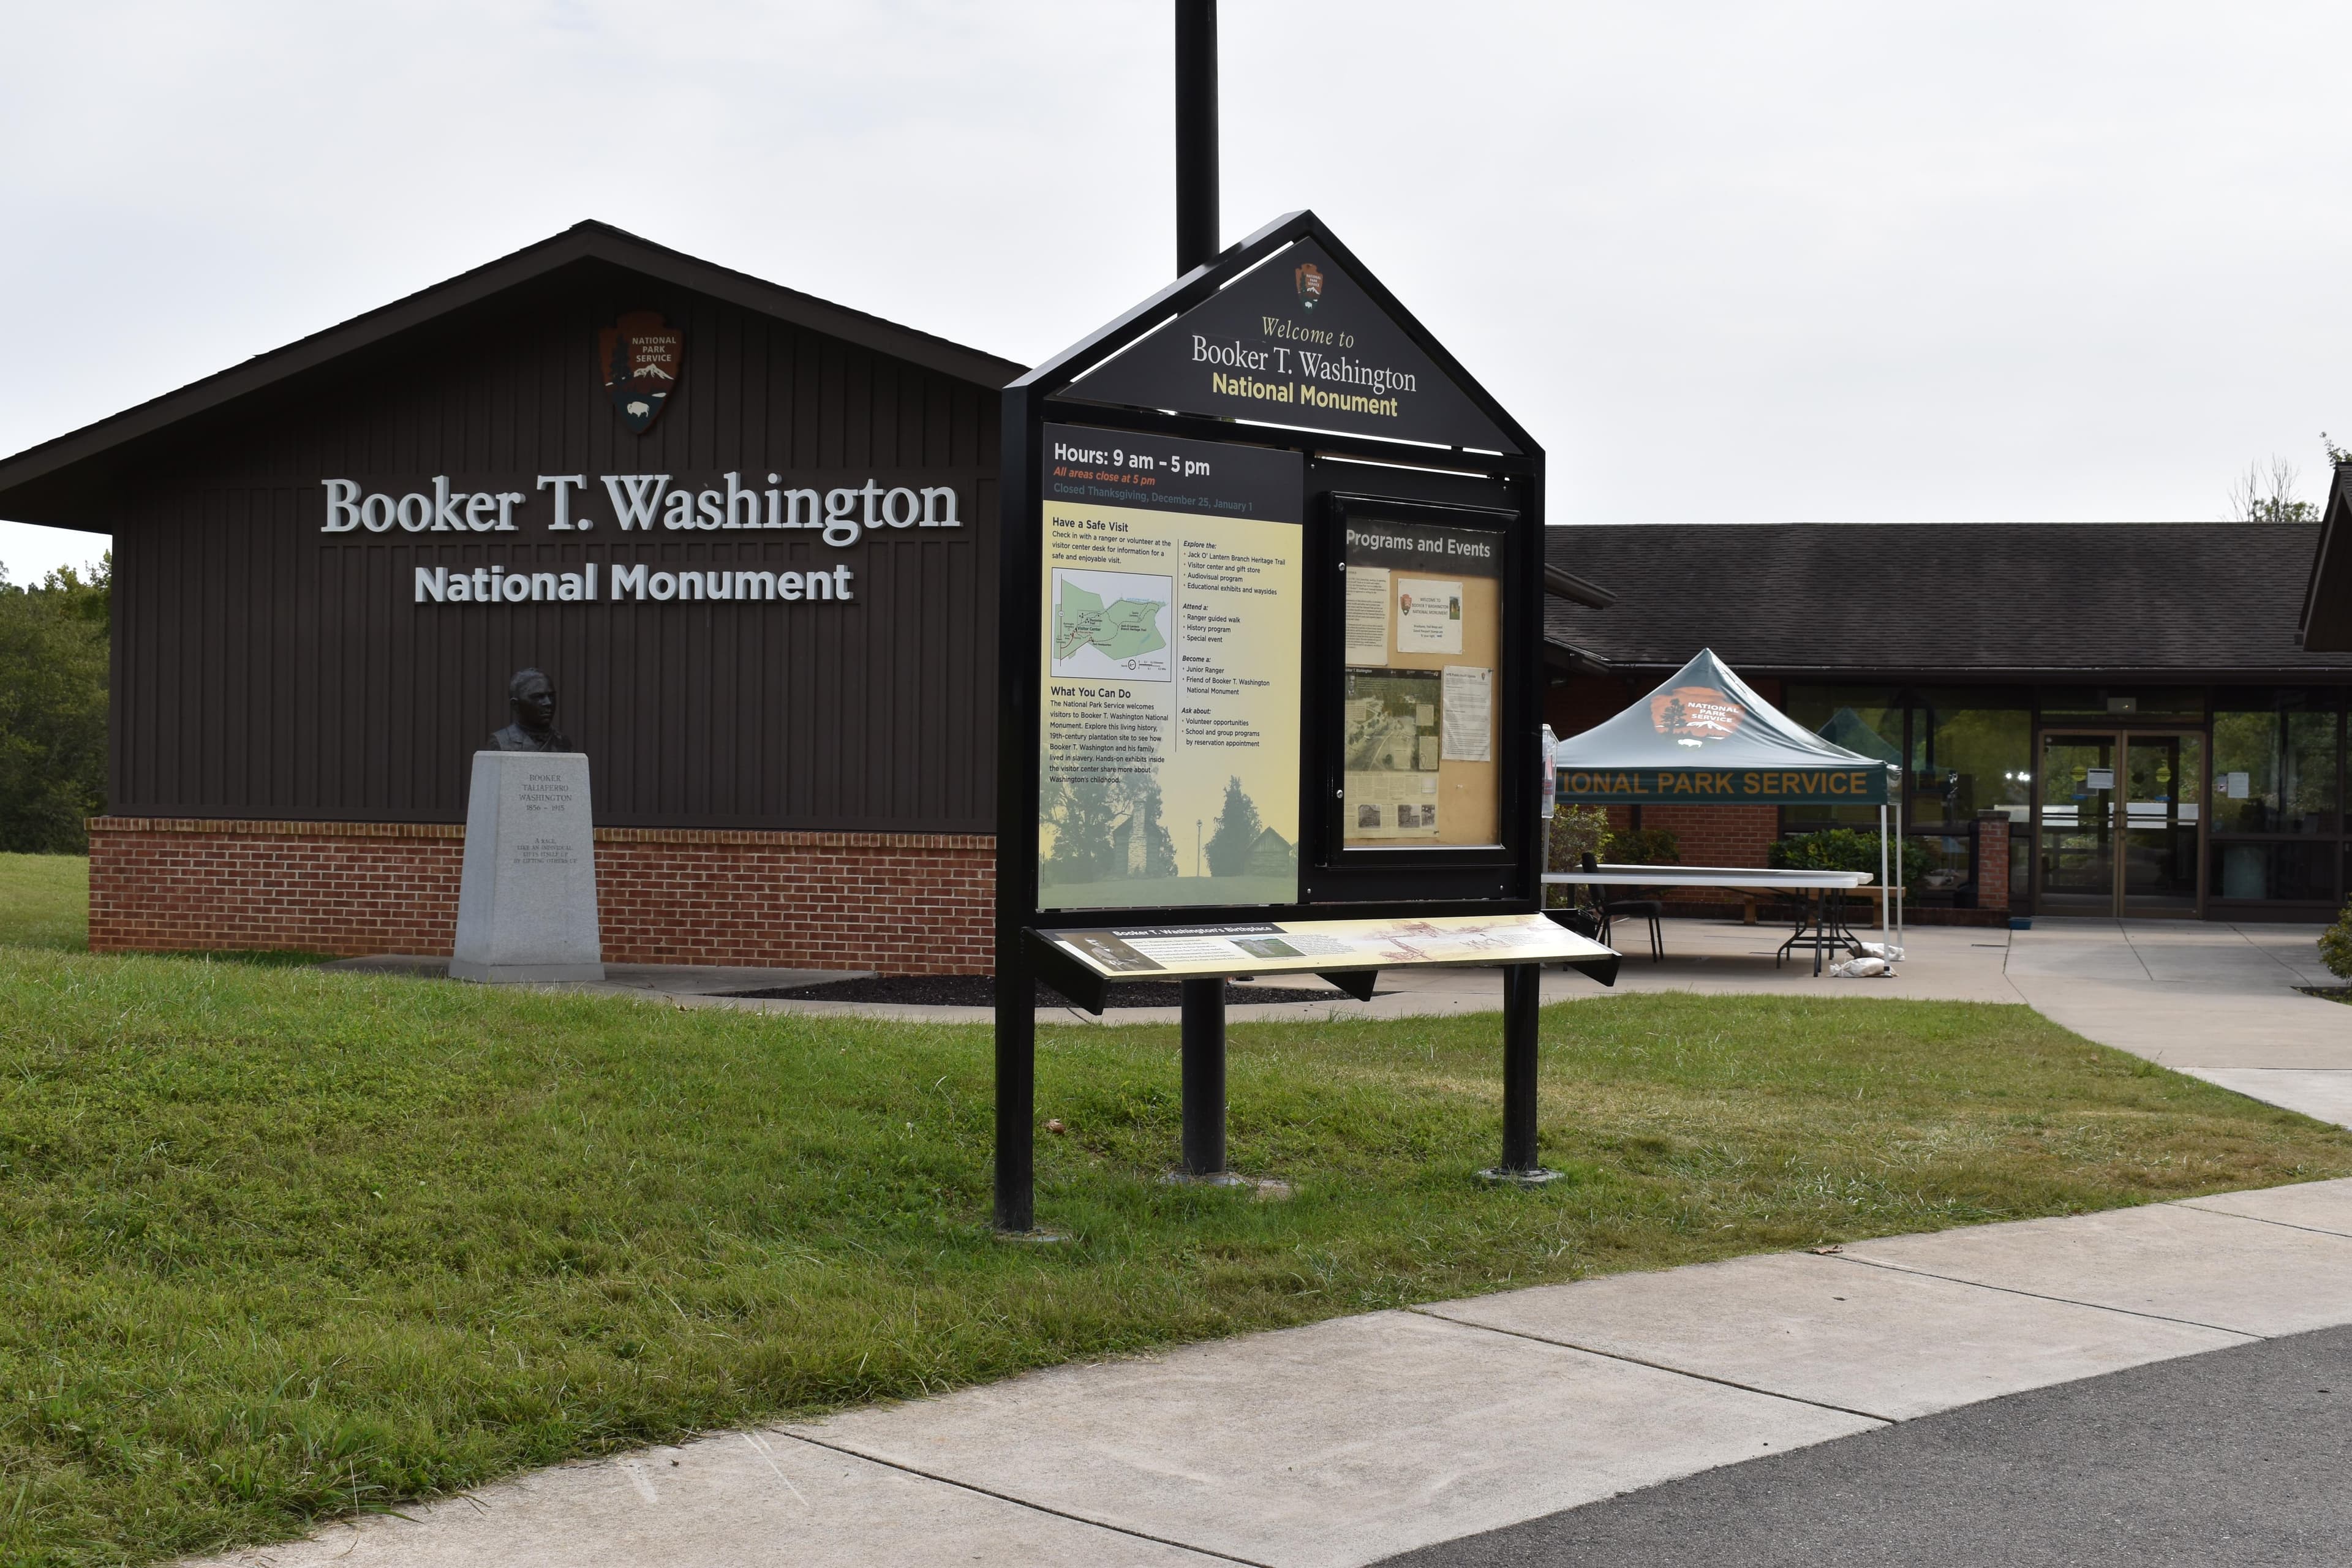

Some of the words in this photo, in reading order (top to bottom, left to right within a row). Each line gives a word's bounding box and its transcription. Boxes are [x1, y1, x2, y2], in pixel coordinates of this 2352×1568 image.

[1262, 316, 1333, 345] Welcome
[1338, 331, 1354, 349] to
[1192, 334, 1268, 371] Booker
[1273, 347, 1292, 374] T.
[1298, 350, 1417, 395] Washington
[1213, 372, 1293, 402] National
[1300, 385, 1398, 417] Monument
[1054, 443, 1108, 465] Hours:
[1114, 450, 1123, 466] 9
[1129, 454, 1153, 469] am
[1171, 456, 1180, 472] 5
[1185, 459, 1210, 477] pm
[1054, 466, 1067, 477] All
[1069, 469, 1094, 479] areas
[1096, 470, 1119, 482] close
[1121, 474, 1130, 483] at
[1133, 475, 1139, 484] 5
[1140, 477, 1155, 486] pm
[320, 475, 524, 533] Booker
[536, 474, 594, 530] T.
[600, 471, 963, 546] Washington
[1054, 483, 1085, 494] Closed
[1087, 486, 1149, 502] Thanksgiving,
[1152, 492, 1196, 505] December
[1197, 497, 1211, 508] 25,
[1213, 499, 1246, 511] January
[1248, 502, 1253, 511] 1
[1053, 517, 1075, 527] Have
[1087, 520, 1106, 530] Safe
[1109, 522, 1128, 532] Visit
[1346, 529, 1413, 550] Programs
[1417, 538, 1443, 553] and
[1447, 539, 1490, 557] Events
[414, 562, 597, 603] National
[610, 564, 854, 600] Monument
[1050, 687, 1076, 696] What
[1079, 688, 1095, 697] You
[1098, 688, 1115, 698] Can
[1118, 689, 1131, 698] Do
[1688, 703, 1739, 713] NATIONAL
[1691, 714, 1732, 722] SERVICE
[1658, 773, 1735, 794] PARK
[1743, 772, 1868, 794] SERVICE
